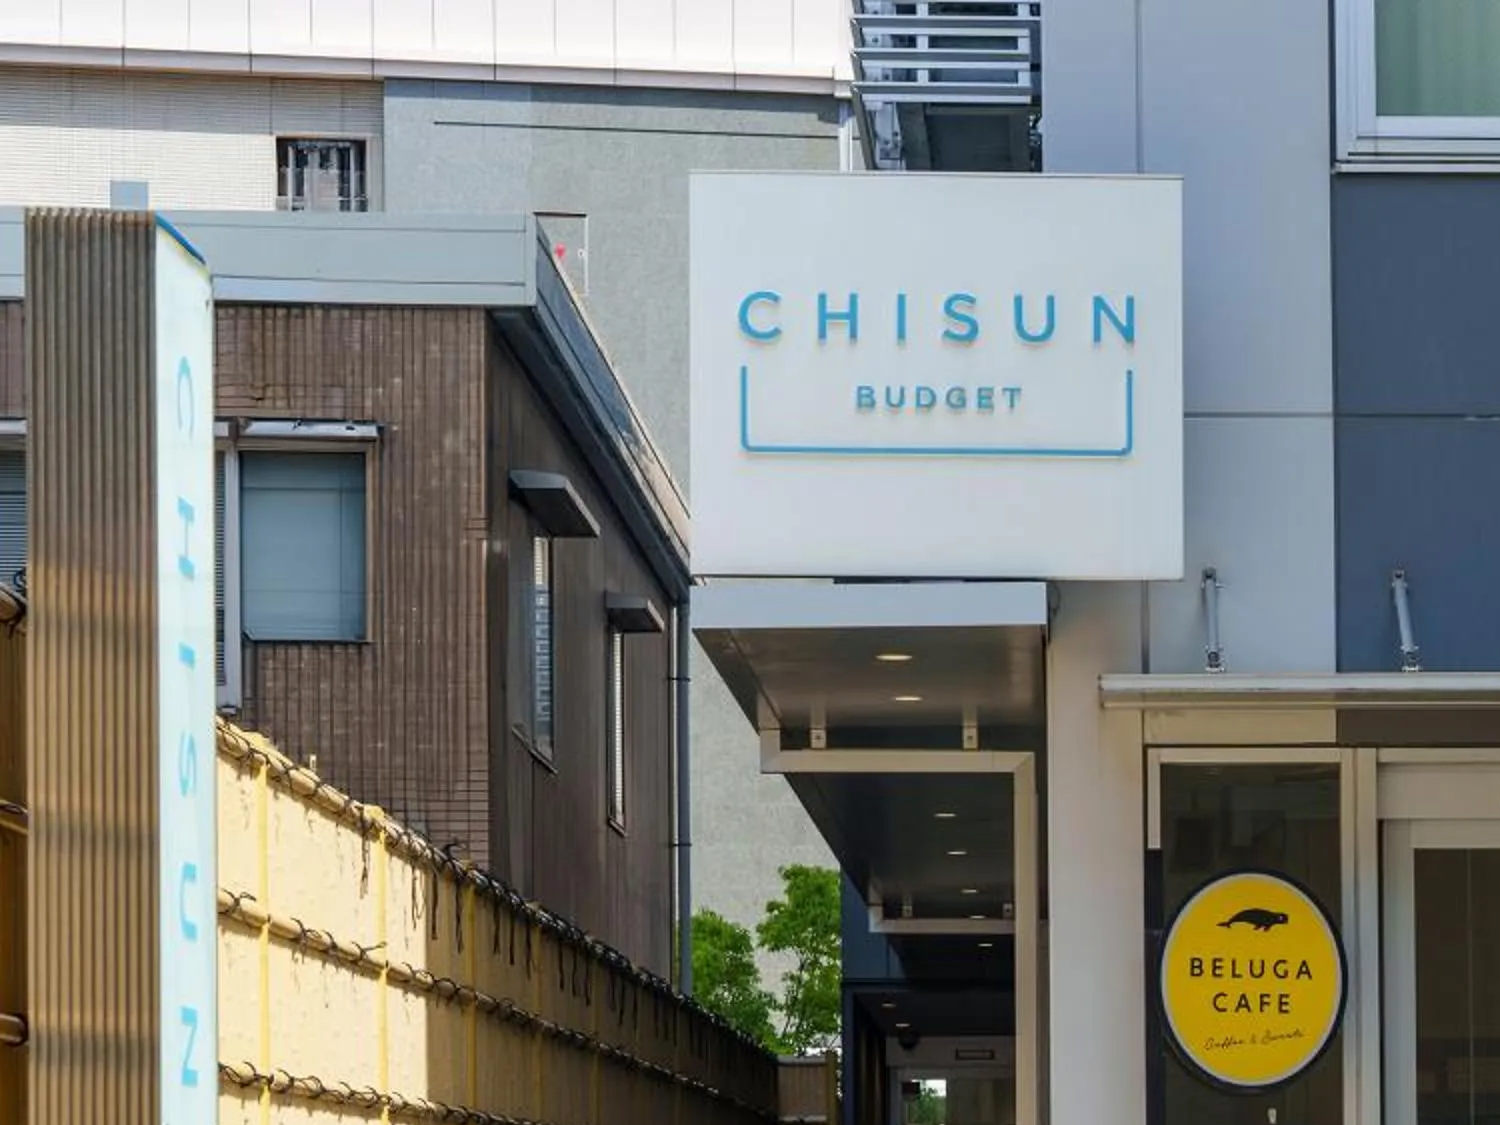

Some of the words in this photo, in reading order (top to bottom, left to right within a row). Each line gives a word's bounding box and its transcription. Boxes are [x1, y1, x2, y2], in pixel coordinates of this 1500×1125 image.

[738, 291, 1136, 344] CHISUN
[856, 385, 1023, 411] BUDGET
[177, 358, 197, 1086] CHISUN
[1189, 957, 1313, 980] BELUGA
[1212, 992, 1290, 1014] CAFE
[1204, 1037, 1243, 1051] Coffee
